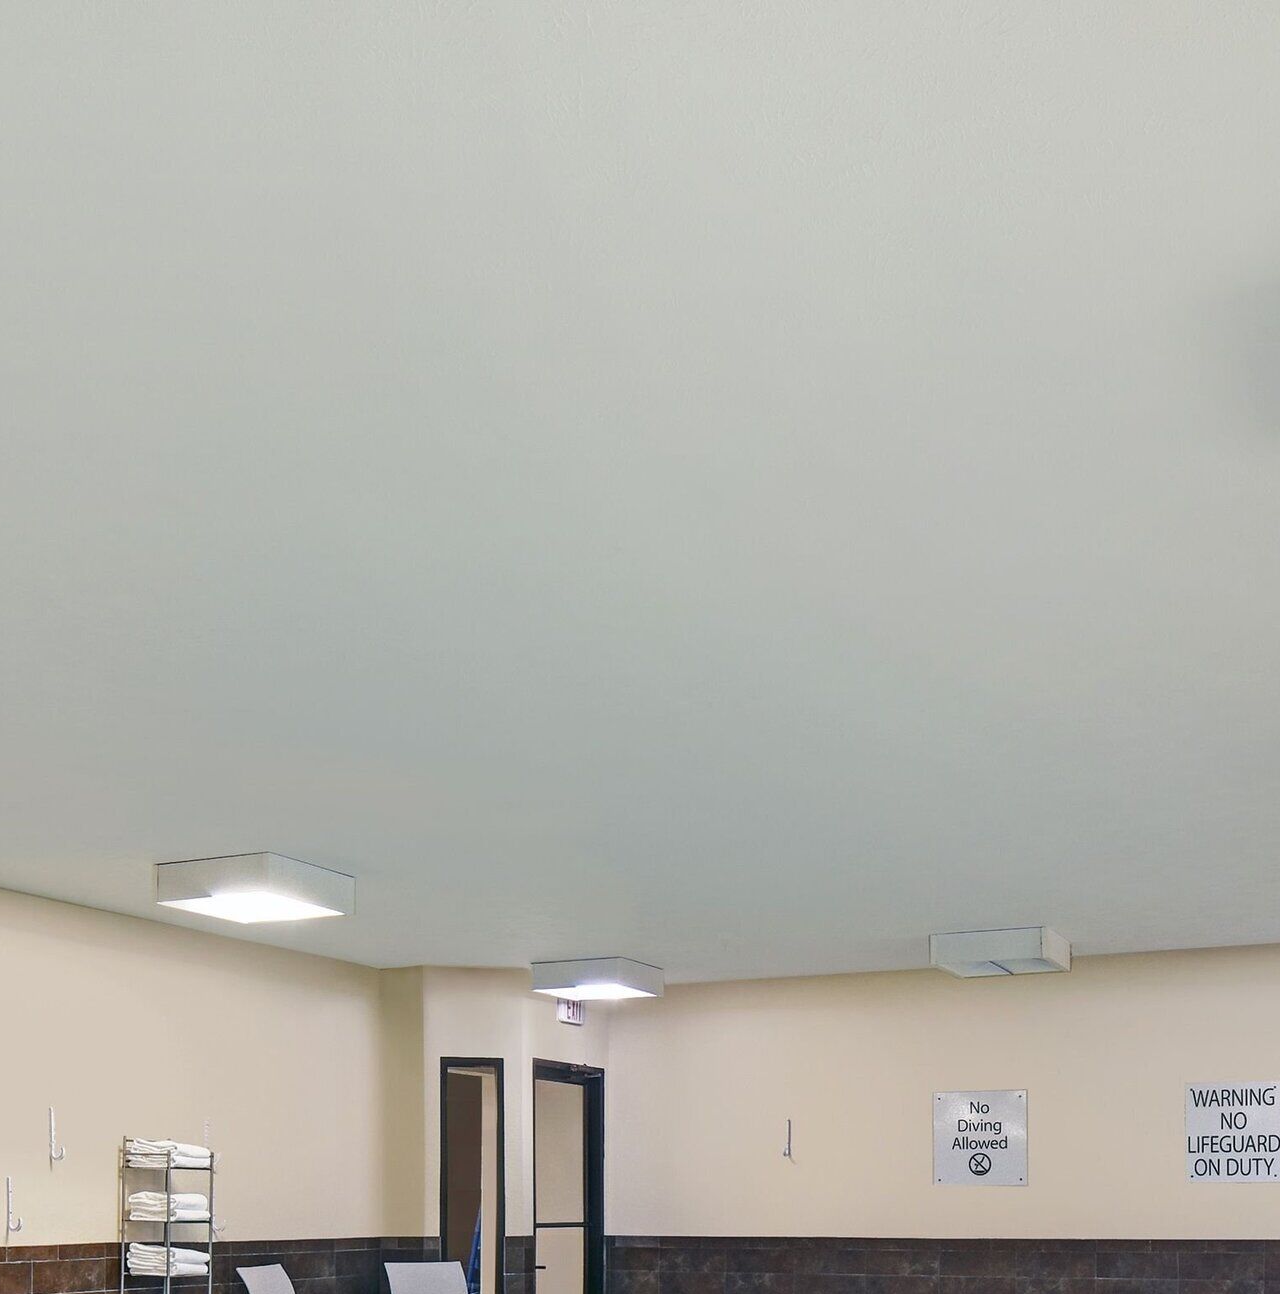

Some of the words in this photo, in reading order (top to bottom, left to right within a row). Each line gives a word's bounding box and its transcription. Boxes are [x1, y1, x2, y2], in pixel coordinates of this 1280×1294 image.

[1192, 1088, 1275, 1107] WARNING
[969, 1101, 990, 1114] No
[957, 1119, 1002, 1135] Diving
[1220, 1111, 1247, 1130] NO
[952, 1136, 1008, 1150] Allowed
[1188, 1134, 1280, 1154] LIFEGUARD
[1194, 1158, 1220, 1176] ON
[1226, 1157, 1275, 1176] DUTY
